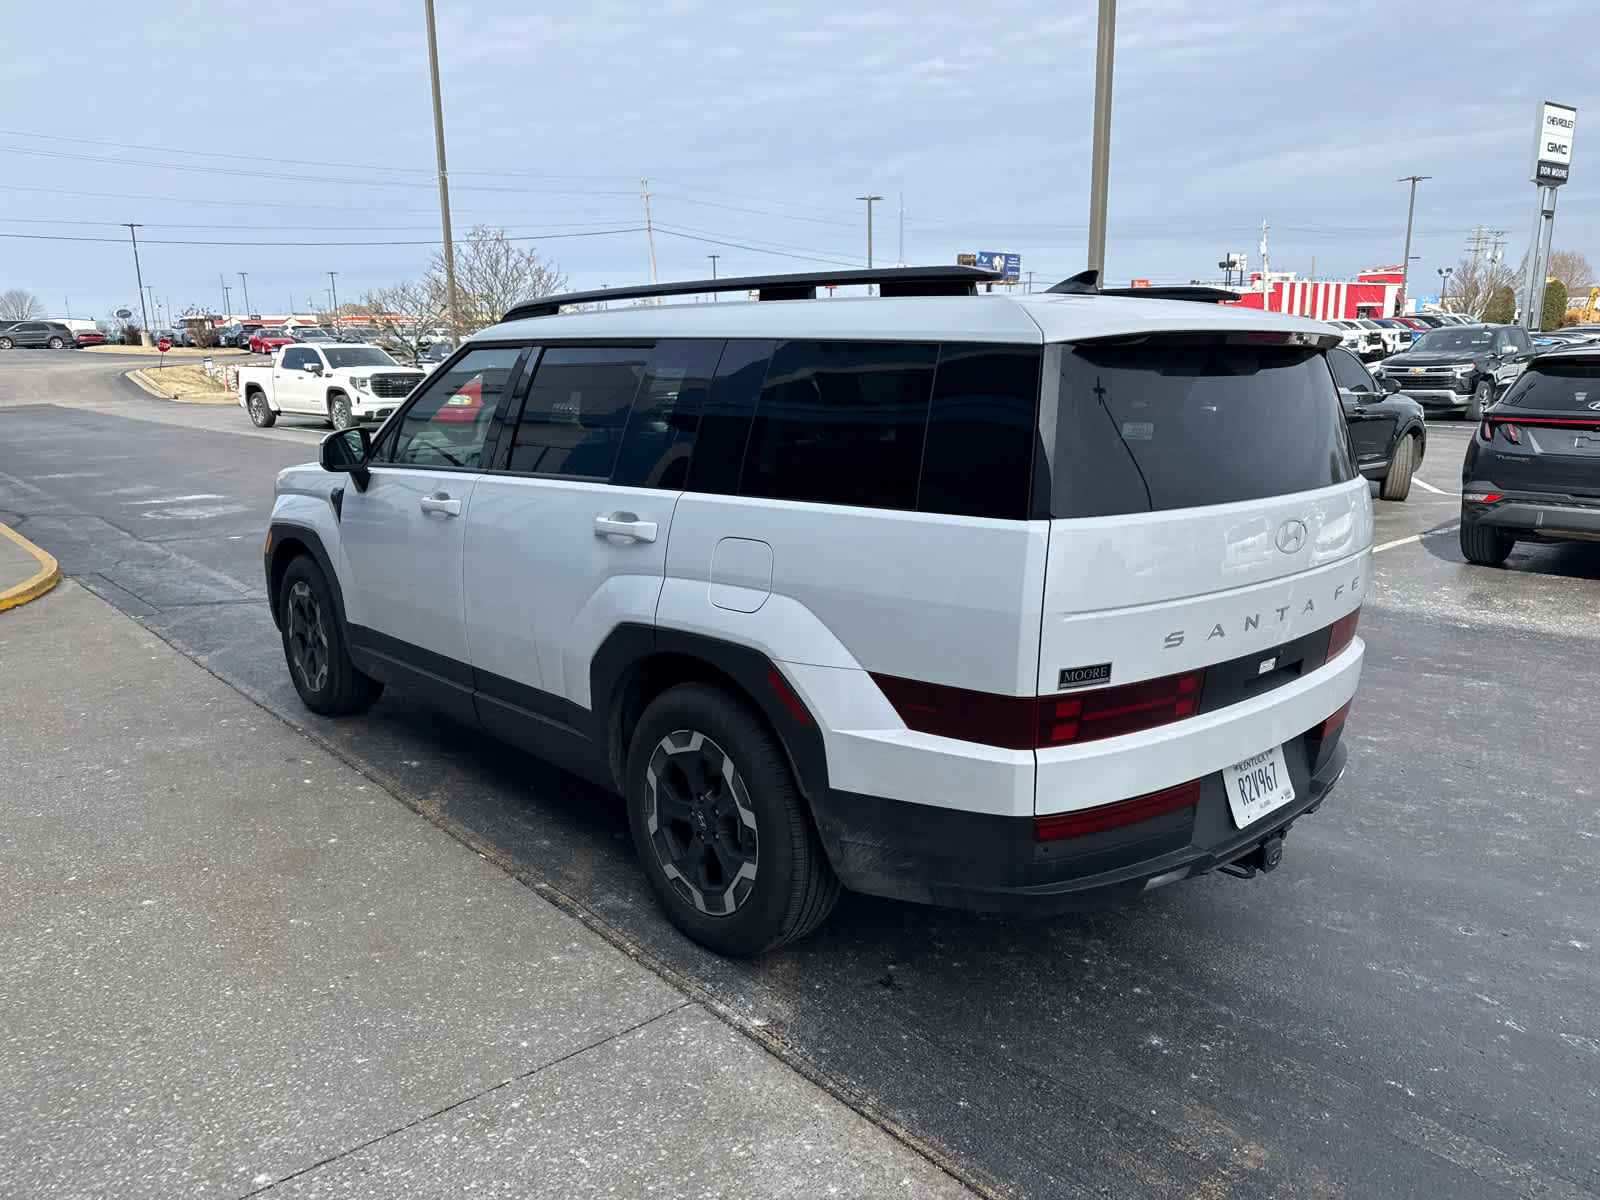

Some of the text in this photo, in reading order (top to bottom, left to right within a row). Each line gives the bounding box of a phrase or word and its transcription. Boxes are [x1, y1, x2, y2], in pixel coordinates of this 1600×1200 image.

[1546, 115, 1574, 129] CHEVROLET
[1547, 141, 1568, 155] GMC
[1162, 575, 1361, 650] SANTA FE
[1064, 667, 1108, 682] MOORE
[1239, 752, 1270, 772] KENTUCKY
[1238, 761, 1278, 806] R2V967
